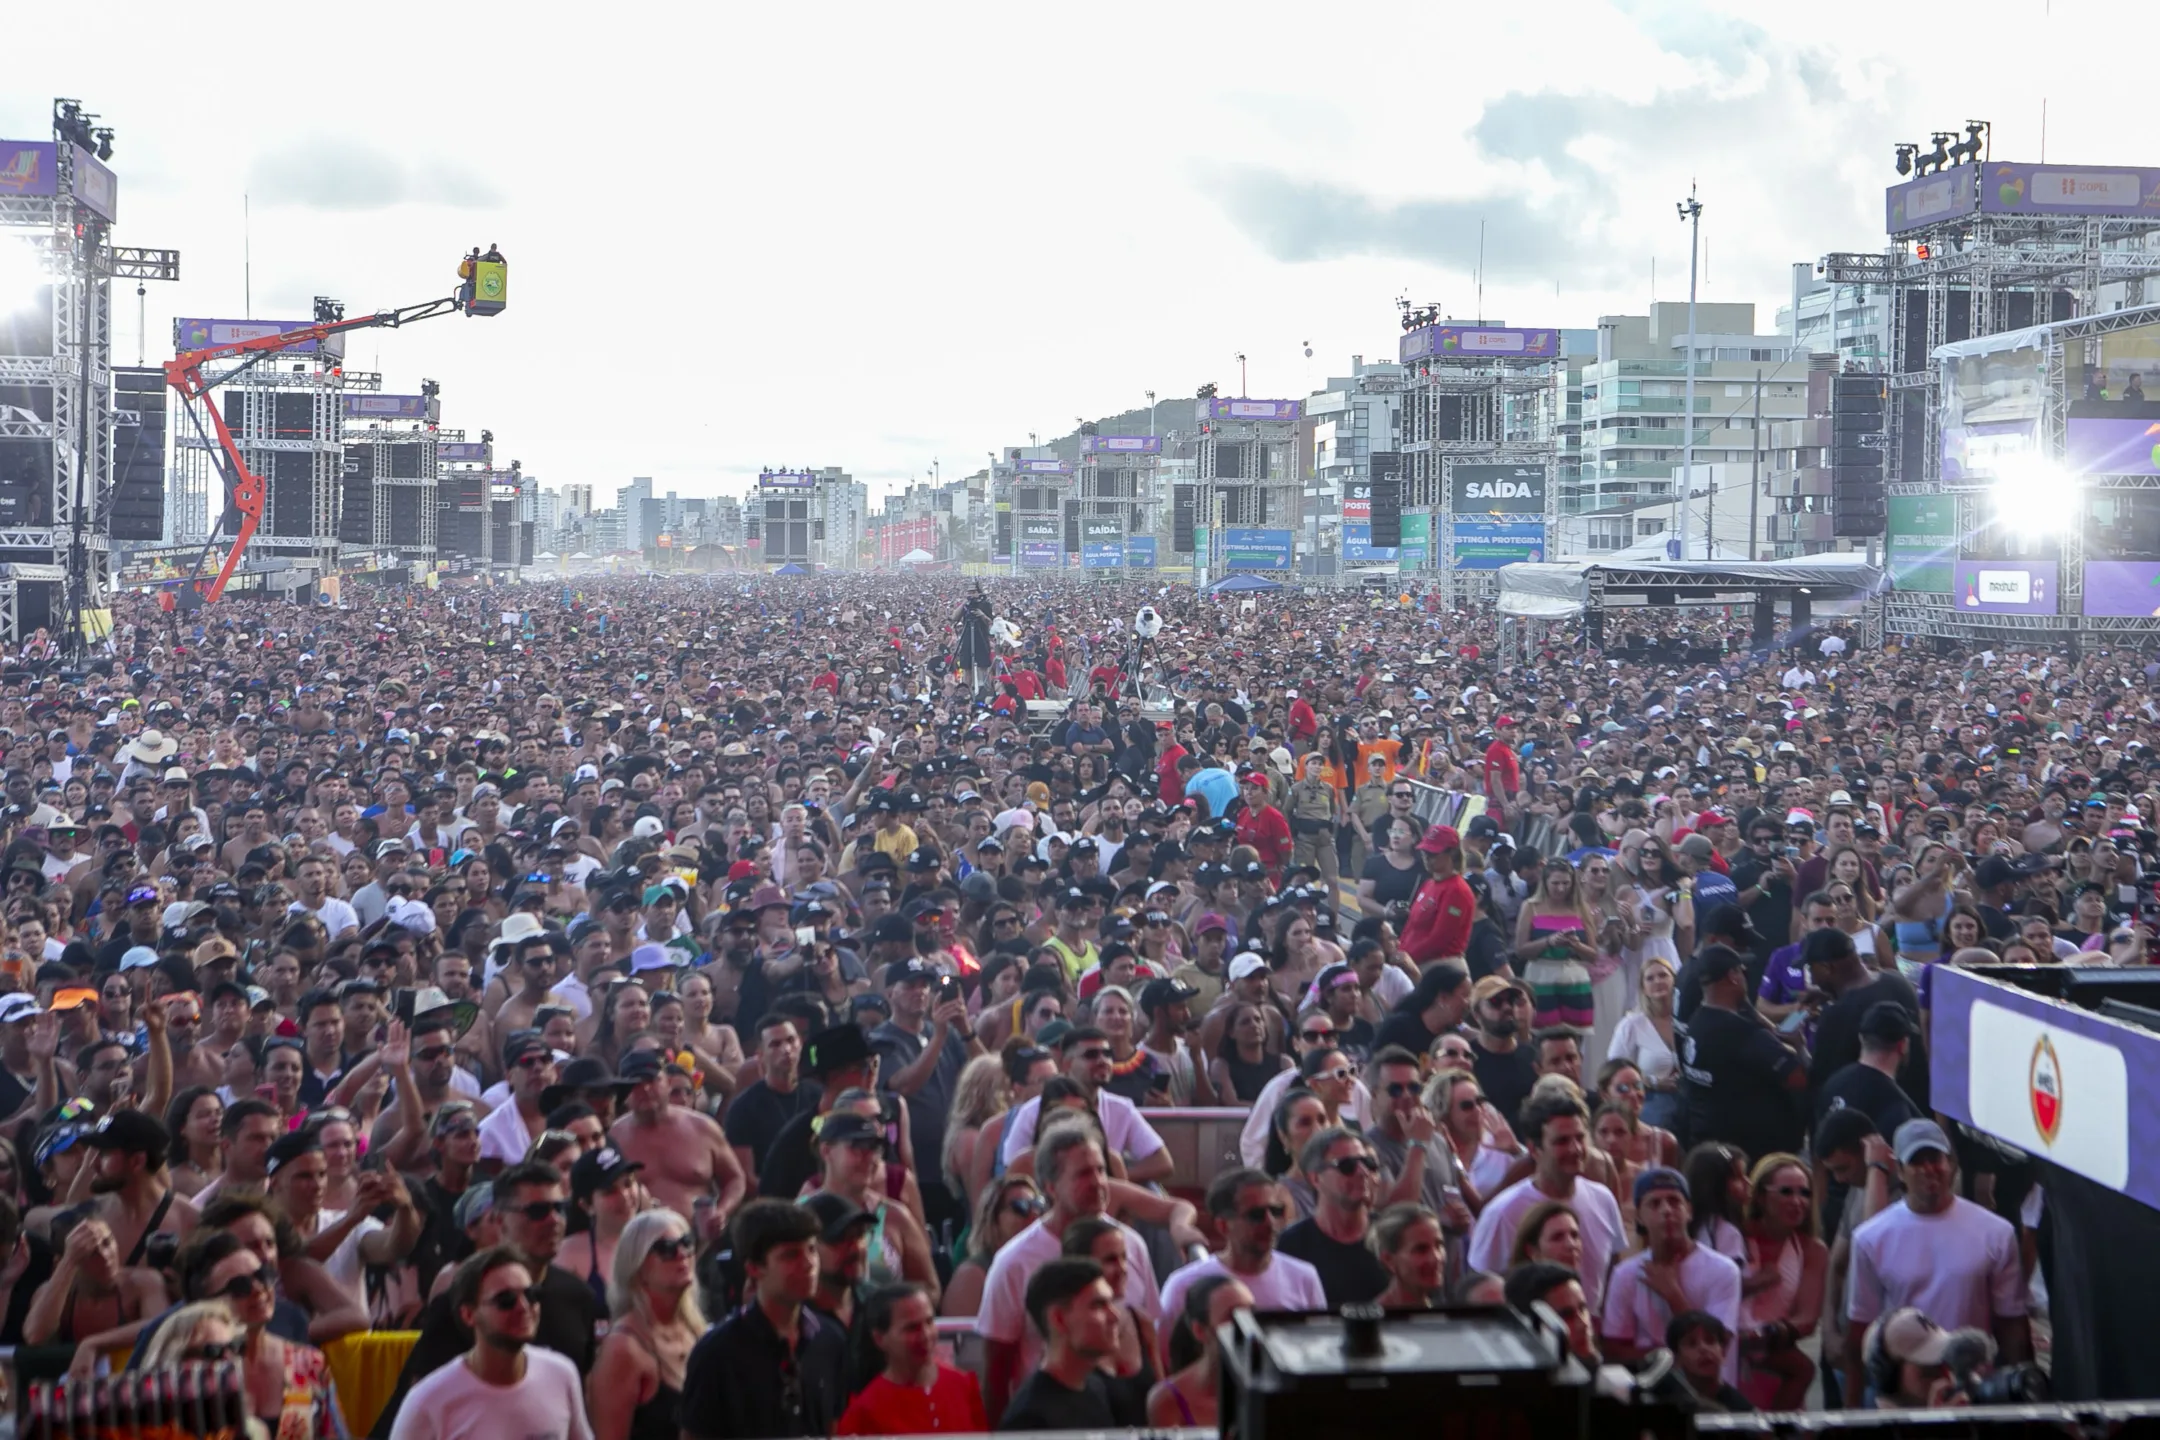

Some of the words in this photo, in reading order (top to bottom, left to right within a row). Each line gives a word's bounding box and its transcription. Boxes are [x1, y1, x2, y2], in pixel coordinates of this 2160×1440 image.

[2079, 182, 2109, 193] COPEL
[1465, 478, 1532, 498] SAÍDA
[1027, 526, 1053, 534] SAÍDA
[1088, 525, 1116, 535] SAÍDA
[1346, 536, 1368, 544] ÁGUA
[134, 548, 164, 559] PARADA
[165, 548, 175, 557] DA
